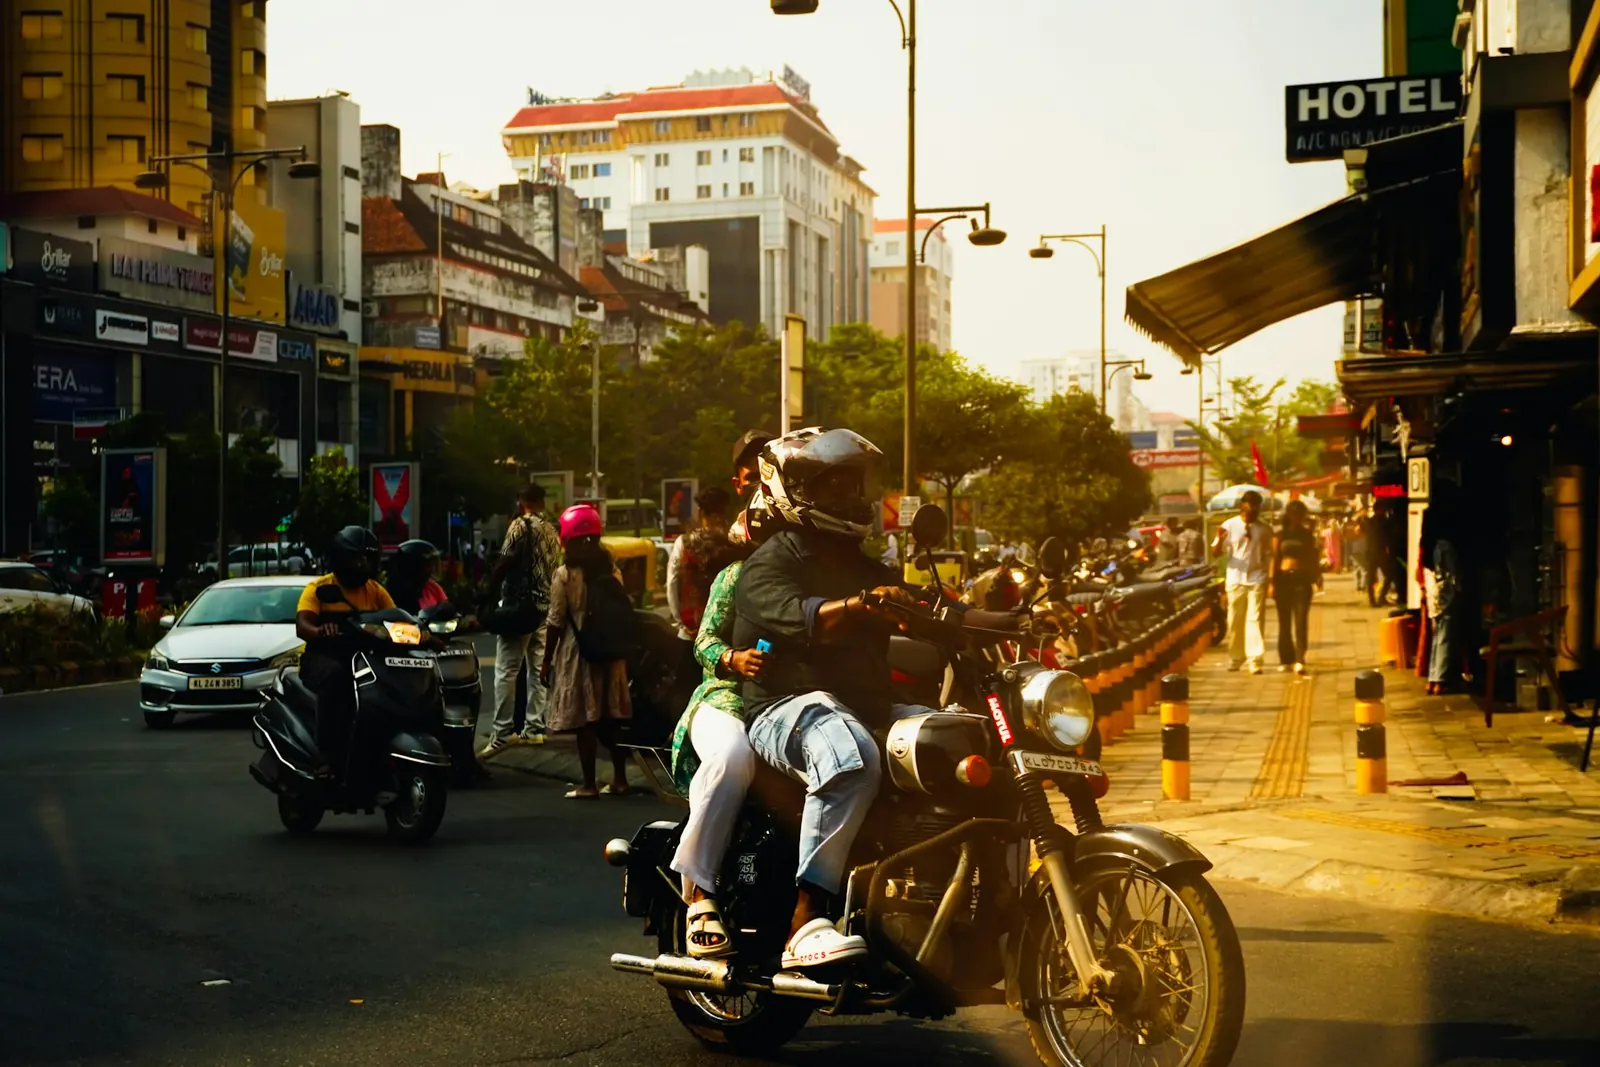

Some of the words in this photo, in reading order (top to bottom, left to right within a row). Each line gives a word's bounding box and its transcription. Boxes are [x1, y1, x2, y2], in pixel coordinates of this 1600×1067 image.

[1297, 77, 1458, 122] HOTEL
[293, 284, 338, 326] ABAD
[987, 697, 1012, 744] MOTUL
[738, 855, 756, 864] FAST
[740, 864, 751, 873] AS
[800, 951, 827, 963] crocs
